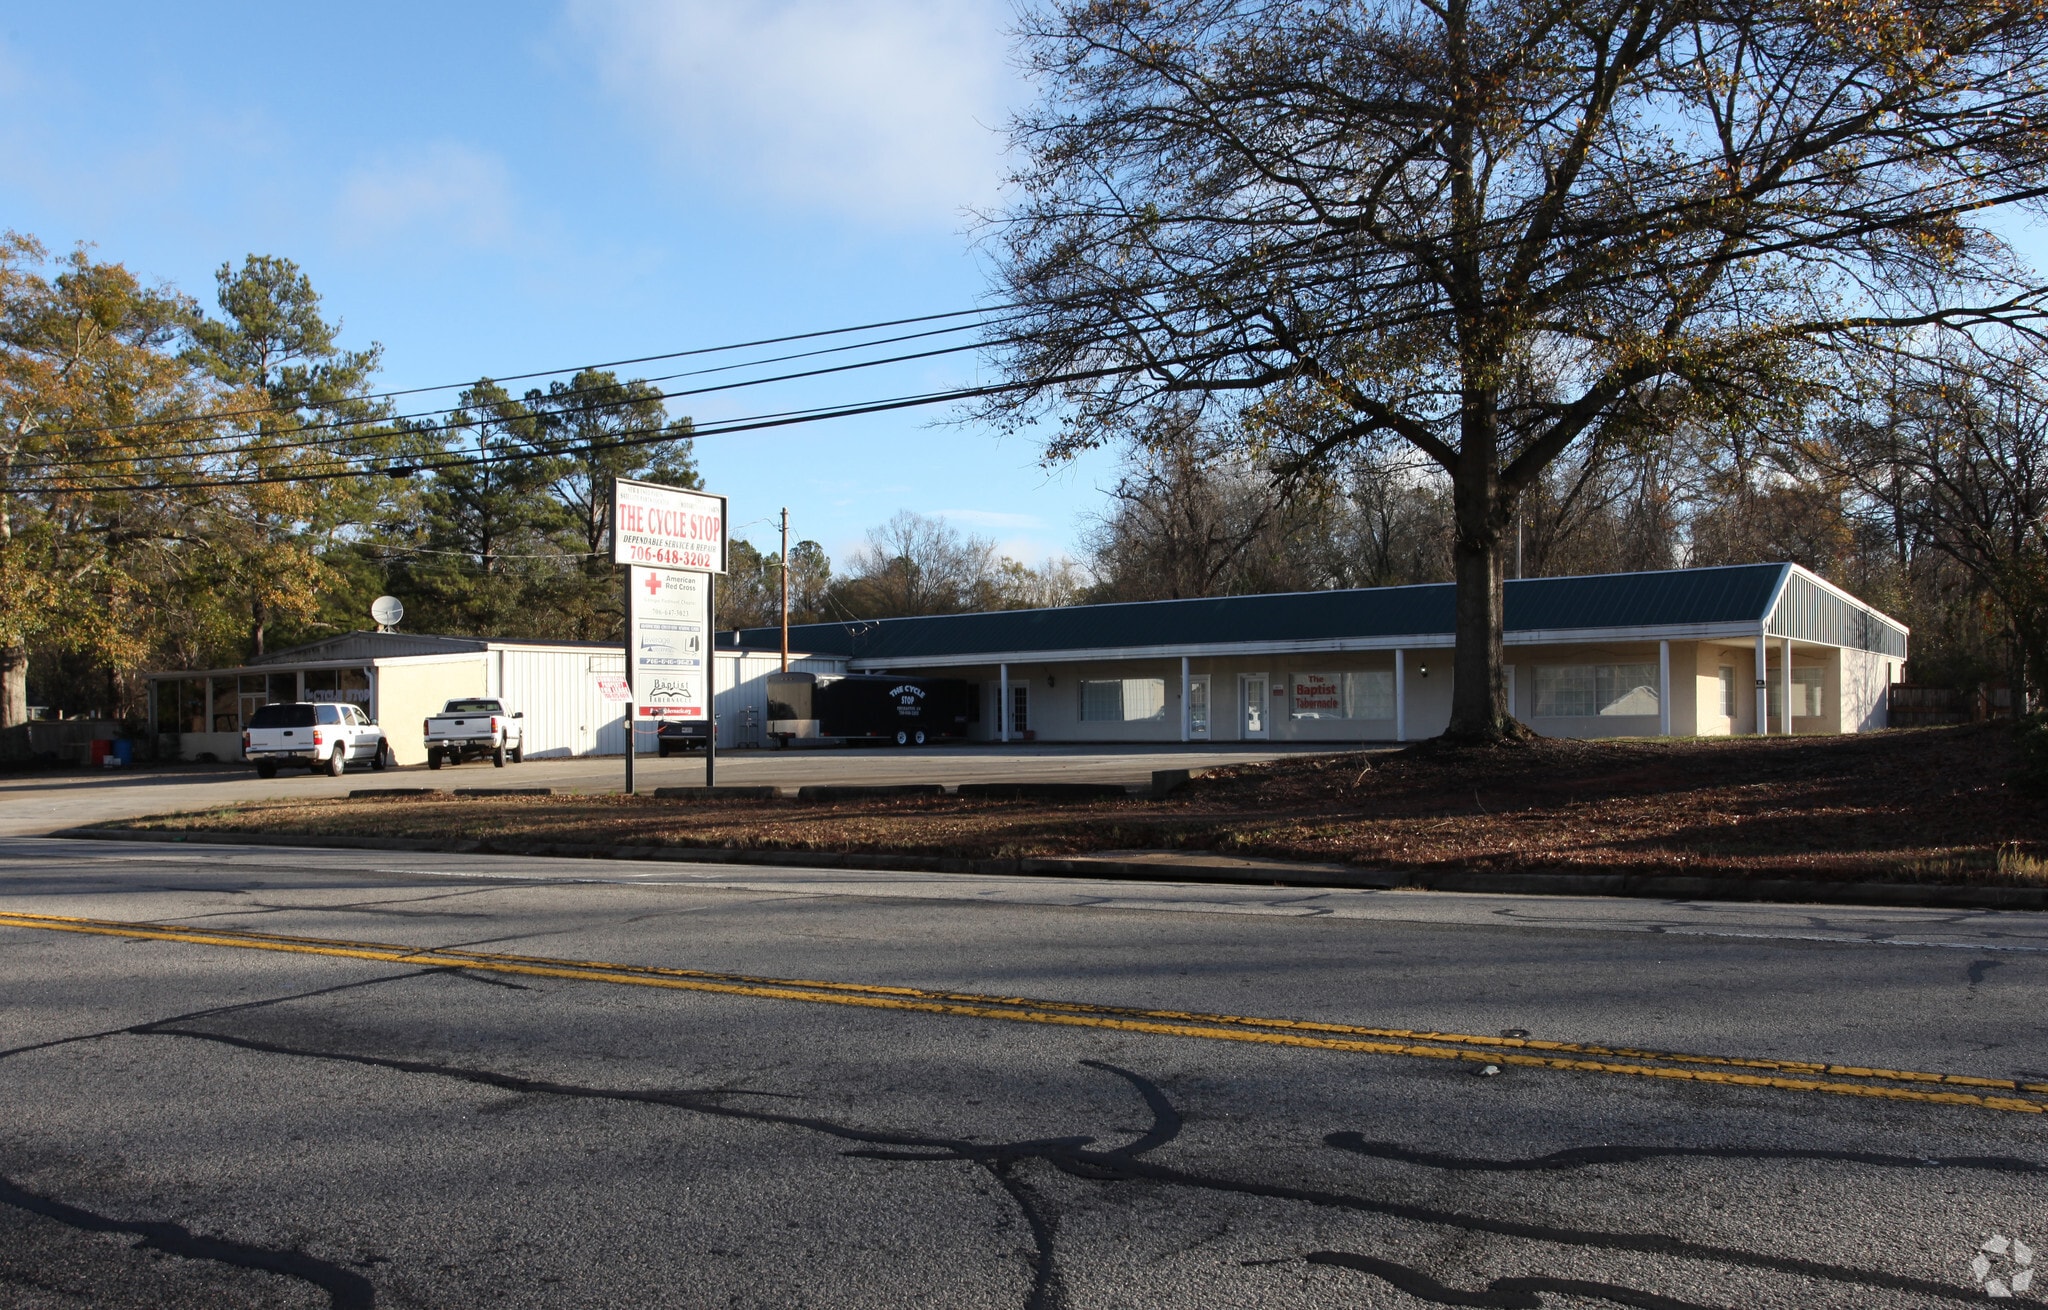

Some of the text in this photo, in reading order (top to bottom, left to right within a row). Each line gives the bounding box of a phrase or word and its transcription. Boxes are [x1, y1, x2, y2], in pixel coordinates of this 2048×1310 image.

[619, 503, 720, 542] THE CYCLE STOP
[623, 534, 717, 553] DEPENDABLE SERVICE & REPAIR
[630, 545, 711, 568] 706-648-3202
[666, 575, 696, 584] American
[678, 584, 696, 592] Cross
[654, 679, 689, 691] Baptist
[1308, 675, 1324, 683] The
[889, 685, 926, 699] THE CYCLE
[1296, 683, 1337, 697] Baptist
[901, 695, 915, 705] STOP
[1295, 697, 1338, 709] Tabernacle
